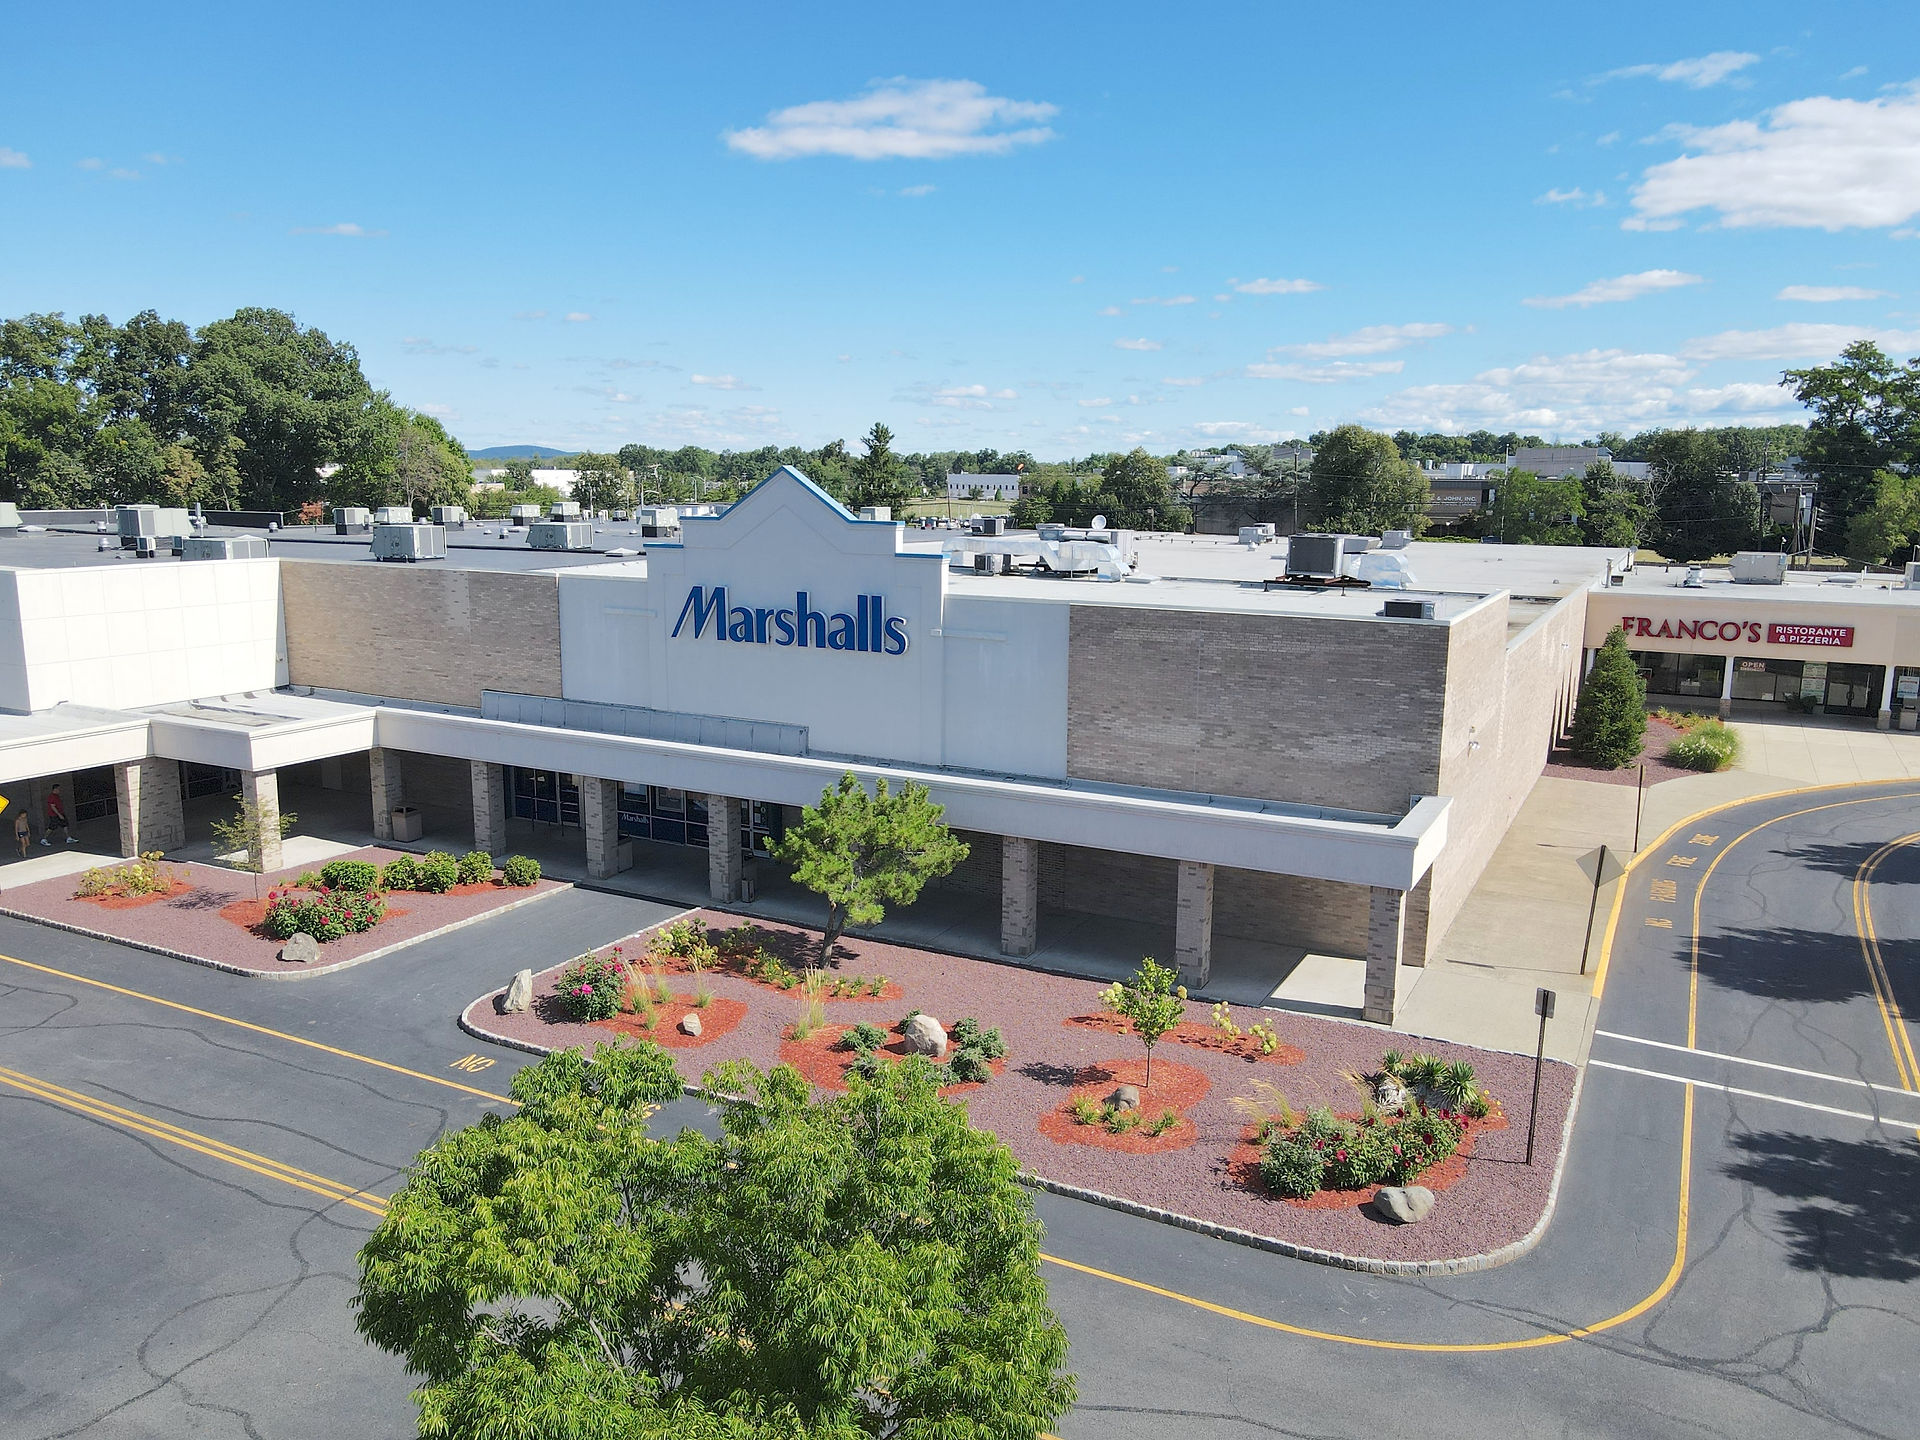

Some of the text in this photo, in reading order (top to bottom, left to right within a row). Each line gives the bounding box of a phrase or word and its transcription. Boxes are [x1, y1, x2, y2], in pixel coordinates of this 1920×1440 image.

[671, 584, 909, 656] Marshalls
[1621, 616, 1762, 643] FRANCO'S
[1775, 626, 1847, 637] RISTORANTE
[1789, 635, 1841, 645] PIZZERIA
[621, 813, 649, 824] Marshalls
[449, 1053, 497, 1073] NO
